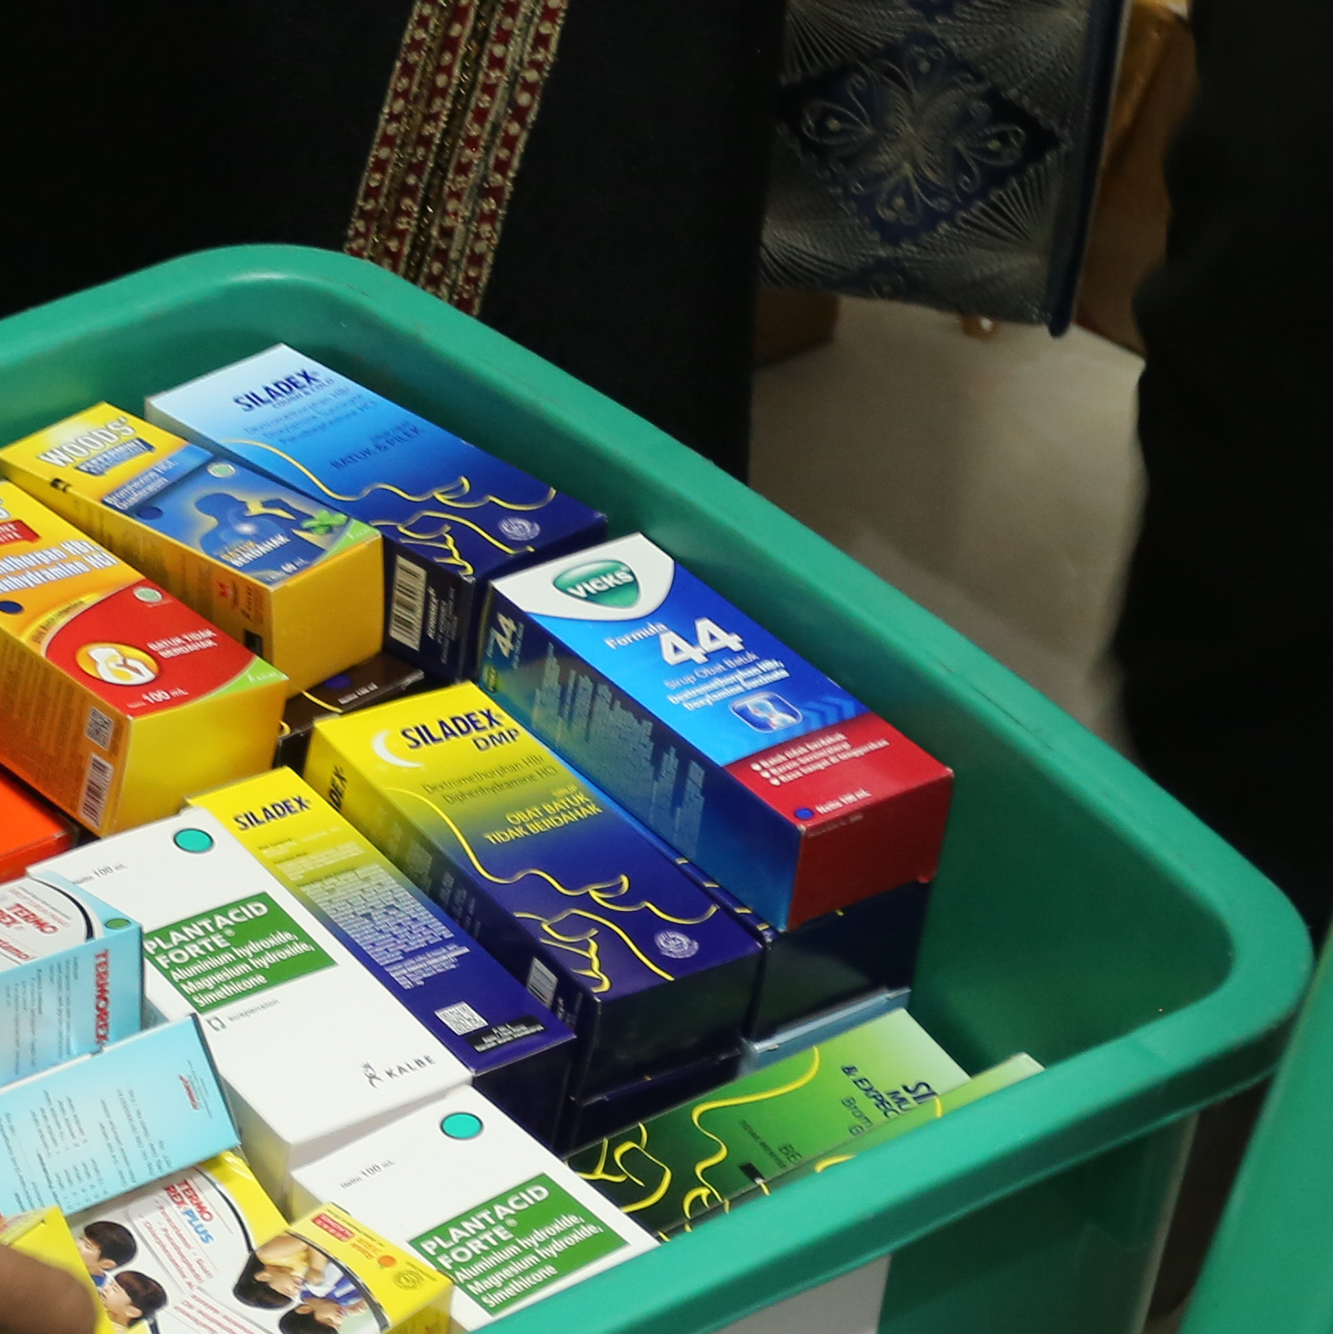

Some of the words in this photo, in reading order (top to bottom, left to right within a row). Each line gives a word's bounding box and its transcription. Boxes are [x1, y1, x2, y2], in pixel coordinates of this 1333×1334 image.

[233, 368, 317, 412] SILADEX
[230, 533, 291, 567] BERDAHAK
[566, 570, 634, 599] VICKS
[146, 636, 185, 651] BATUK
[183, 628, 218, 643] TIDAK
[158, 639, 218, 658] BERDAHAK
[496, 612, 517, 659] 44
[604, 621, 669, 650] Formula
[658, 617, 745, 666] 44
[663, 675, 696, 691] Sirup
[694, 662, 725, 679] Obat
[723, 650, 760, 669] Batuk
[142, 689, 171, 704] 100
[400, 708, 504, 750] SILADEX
[472, 728, 521, 753] DMP
[422, 762, 521, 795] Dextromethorphan
[233, 796, 308, 832] SILADEX
[482, 824, 530, 846] TIDAK
[527, 803, 603, 835] BERDAHAK
[505, 806, 542, 825] OBAT
[541, 791, 593, 815] BATUK
[93, 865, 115, 879] 100
[6, 902, 59, 935] TERMO
[143, 901, 269, 955] PLANTACID
[156, 933, 231, 969] FORTE
[169, 947, 234, 984] Aluminium
[236, 928, 299, 958] hydroxide,
[181, 961, 253, 996] Magnesium
[254, 939, 316, 970] hydroxide,
[95, 949, 111, 1045] TERMOREX
[192, 973, 269, 1008] Simethicone
[385, 1054, 436, 1080] KALBE
[339, 1177, 363, 1190] Netto
[361, 1163, 382, 1179] 100
[163, 1183, 185, 1210] REX
[183, 1208, 214, 1245] PLUS
[176, 1178, 214, 1222] TERMO
[420, 1184, 550, 1256] PLANTACID
[436, 1224, 514, 1270] FORTE
[453, 1241, 519, 1284] Aluminium
[517, 1212, 586, 1252] hydroxide,
[466, 1255, 539, 1296] Magnesium
[539, 1223, 604, 1261] hydroxide,
[481, 1263, 558, 1309] Simethicone
